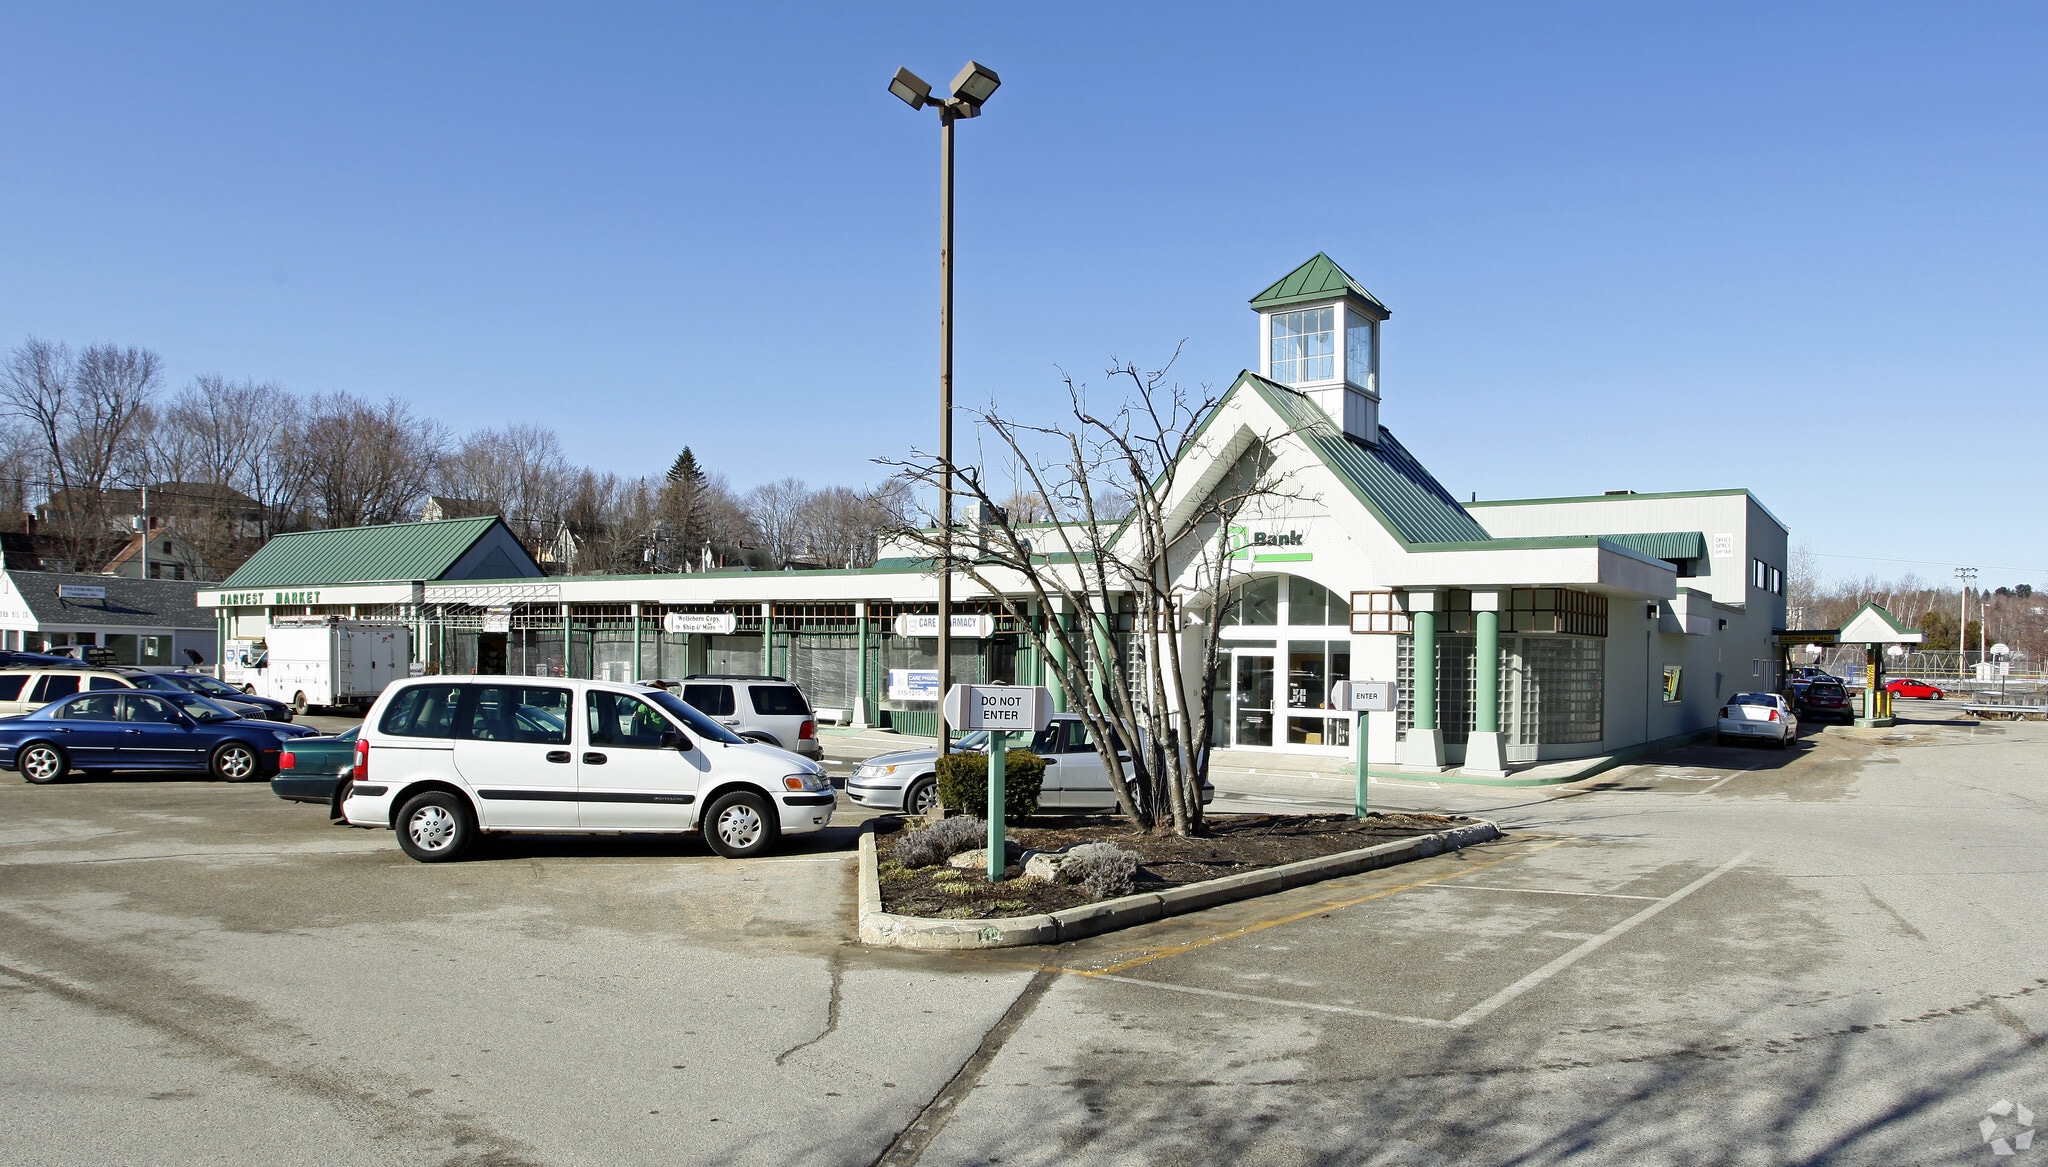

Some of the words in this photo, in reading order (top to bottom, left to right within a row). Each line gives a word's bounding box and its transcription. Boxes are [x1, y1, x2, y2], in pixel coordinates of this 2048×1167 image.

[1253, 530, 1303, 546] Bank
[220, 593, 264, 605] HARVEST
[276, 591, 320, 604] MARKET
[919, 618, 936, 627] CARE
[981, 696, 996, 706] DO
[1000, 697, 1021, 706] NOT
[983, 710, 1018, 720] ENTER
